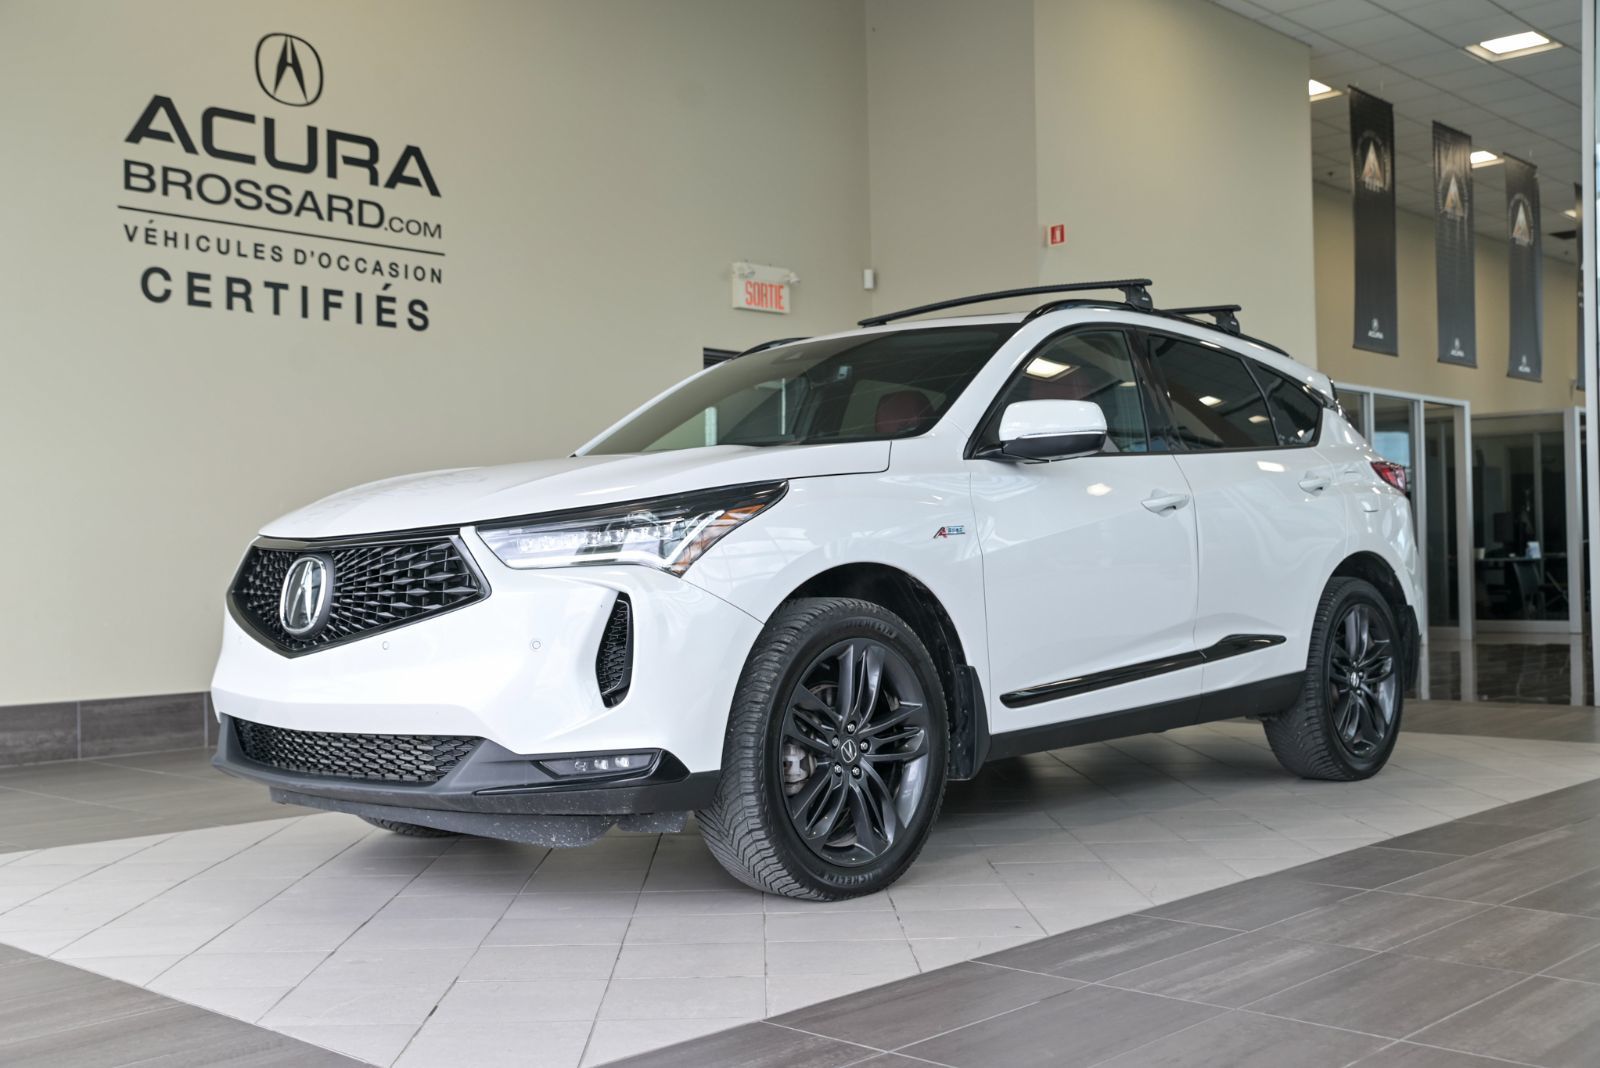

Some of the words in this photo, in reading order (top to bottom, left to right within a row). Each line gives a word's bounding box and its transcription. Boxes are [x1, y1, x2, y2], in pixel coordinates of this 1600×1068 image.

[124, 94, 442, 198] ACURA
[124, 159, 442, 240] BROSSARD.COM
[123, 220, 284, 262] VÉHICULES
[294, 249, 443, 284] D'OCCASION
[140, 266, 430, 333] CERTIFIÉS
[745, 280, 785, 310] SORTIE
